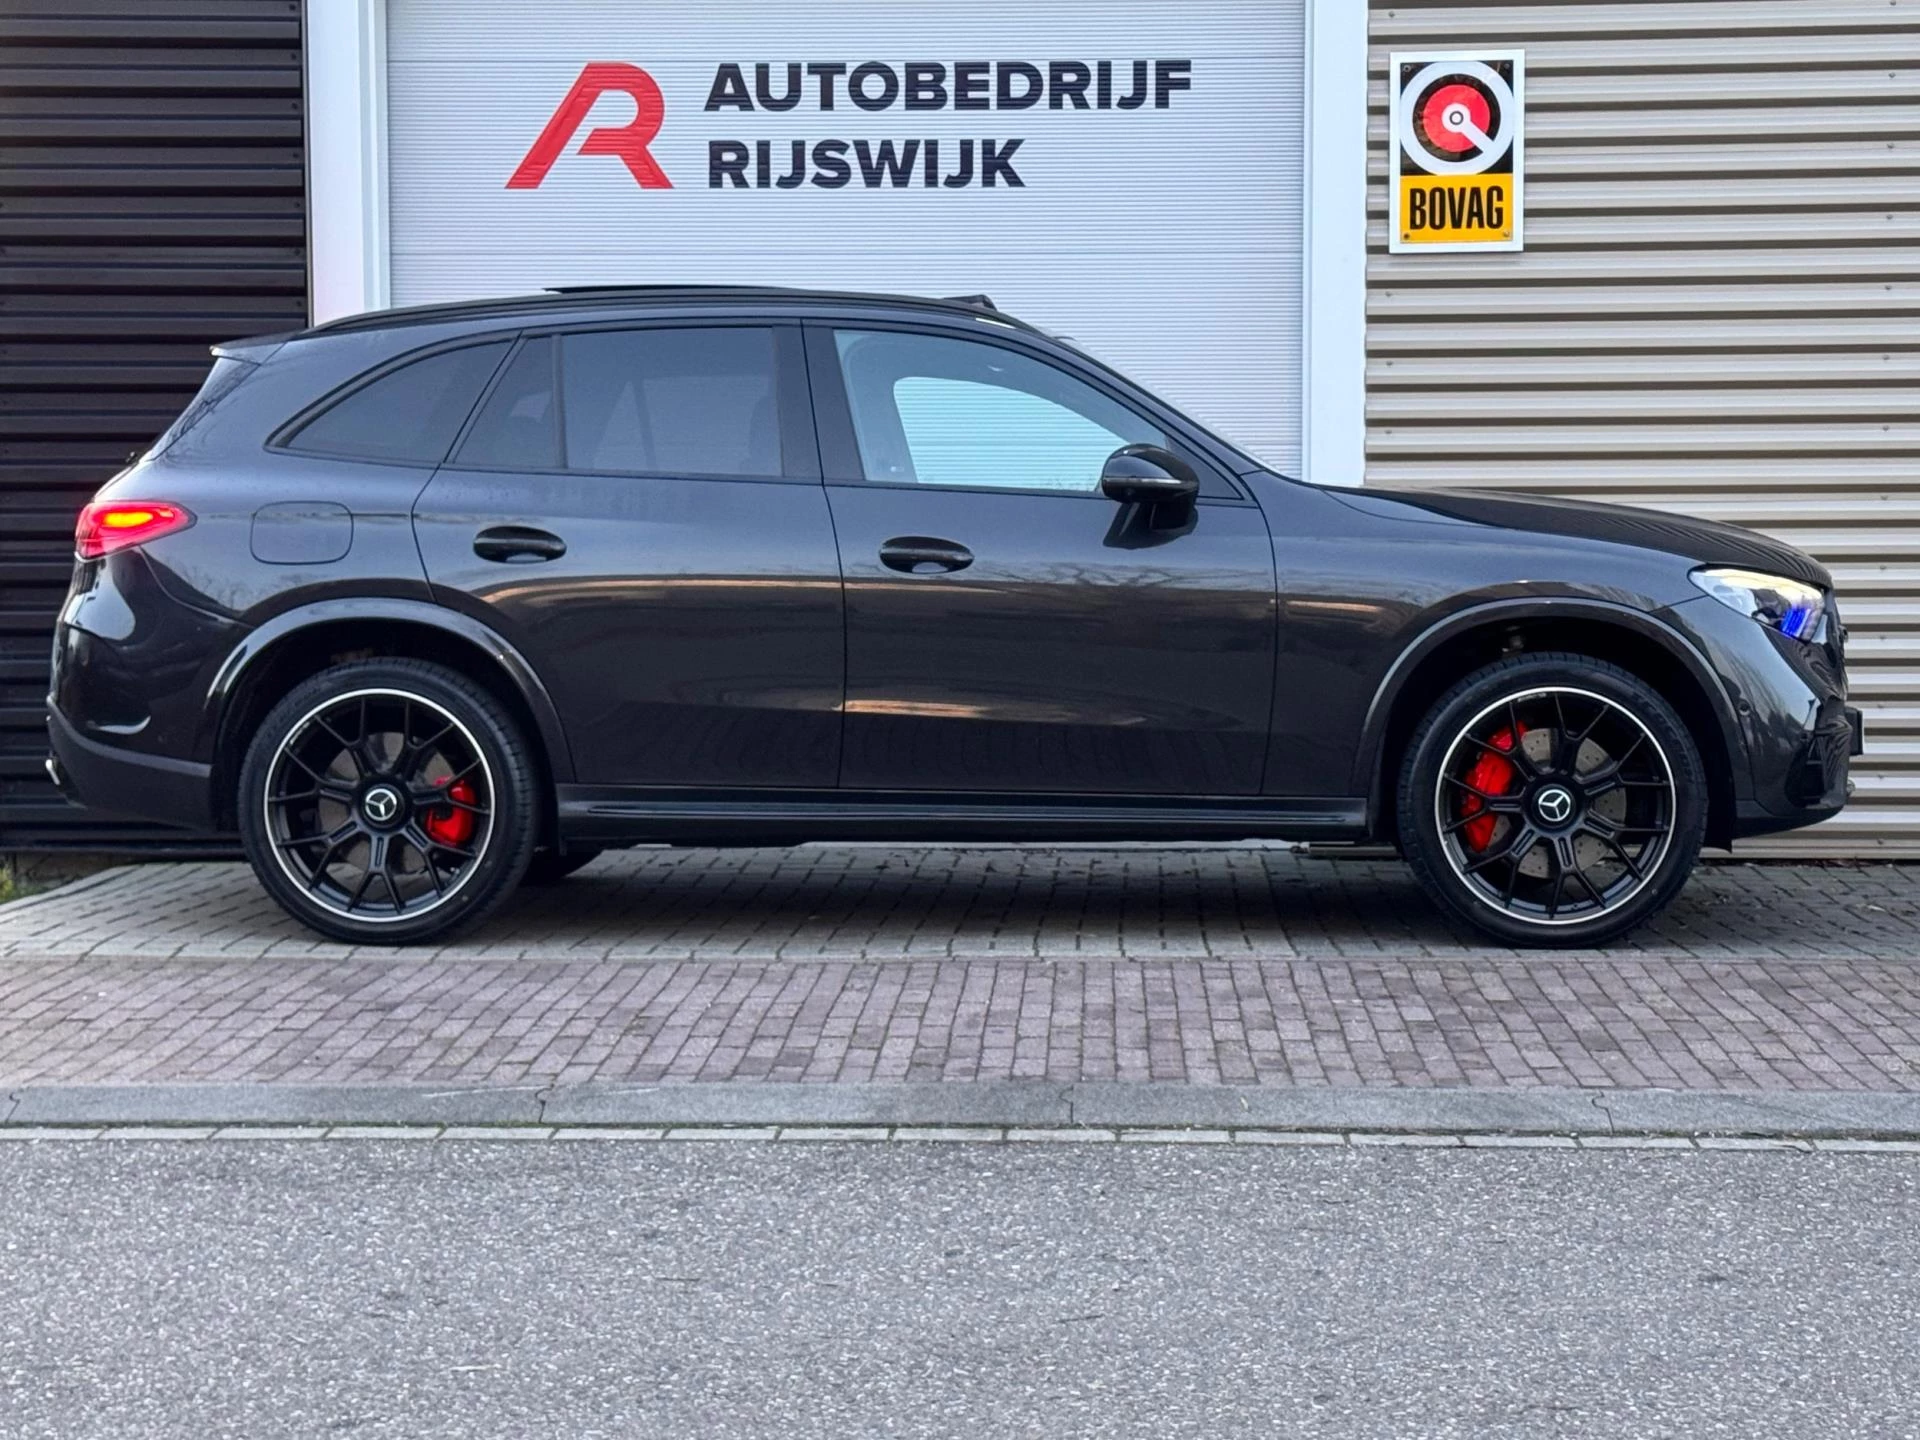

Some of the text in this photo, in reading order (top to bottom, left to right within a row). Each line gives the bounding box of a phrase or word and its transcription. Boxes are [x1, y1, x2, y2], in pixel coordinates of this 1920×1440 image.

[704, 59, 1192, 112] AUTOBEDRIJF
[708, 139, 1026, 190] RIJSWIJK
[1409, 186, 1504, 230] BOVAG
